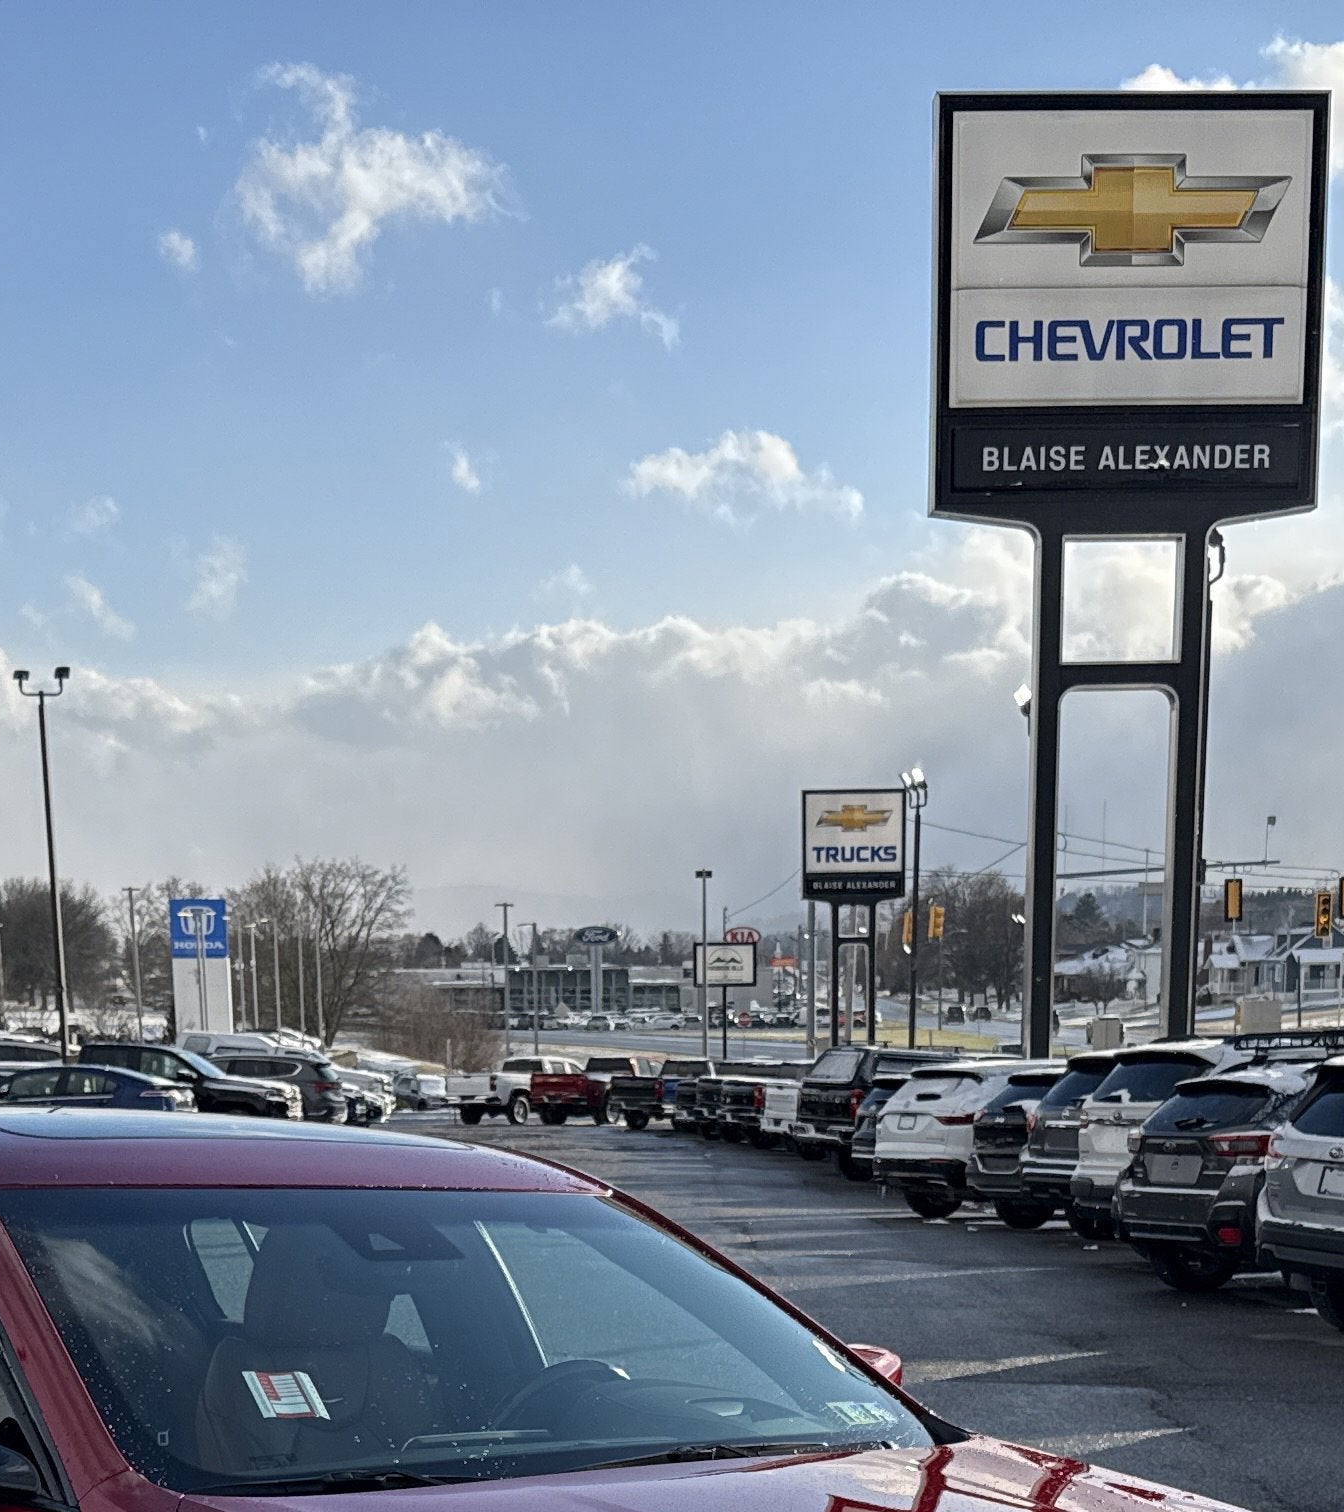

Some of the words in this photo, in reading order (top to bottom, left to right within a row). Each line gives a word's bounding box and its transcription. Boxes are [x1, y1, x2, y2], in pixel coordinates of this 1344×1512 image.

[974, 316, 1285, 363] CHEVROLET
[981, 445, 1086, 472] BLAISE
[1098, 443, 1271, 471] ALEXANDER
[811, 845, 897, 863] TRUCKS
[812, 880, 844, 890] BLAISE
[846, 880, 897, 890] ALEXANDER
[730, 930, 756, 944] KIA
[173, 941, 225, 950] HODA
